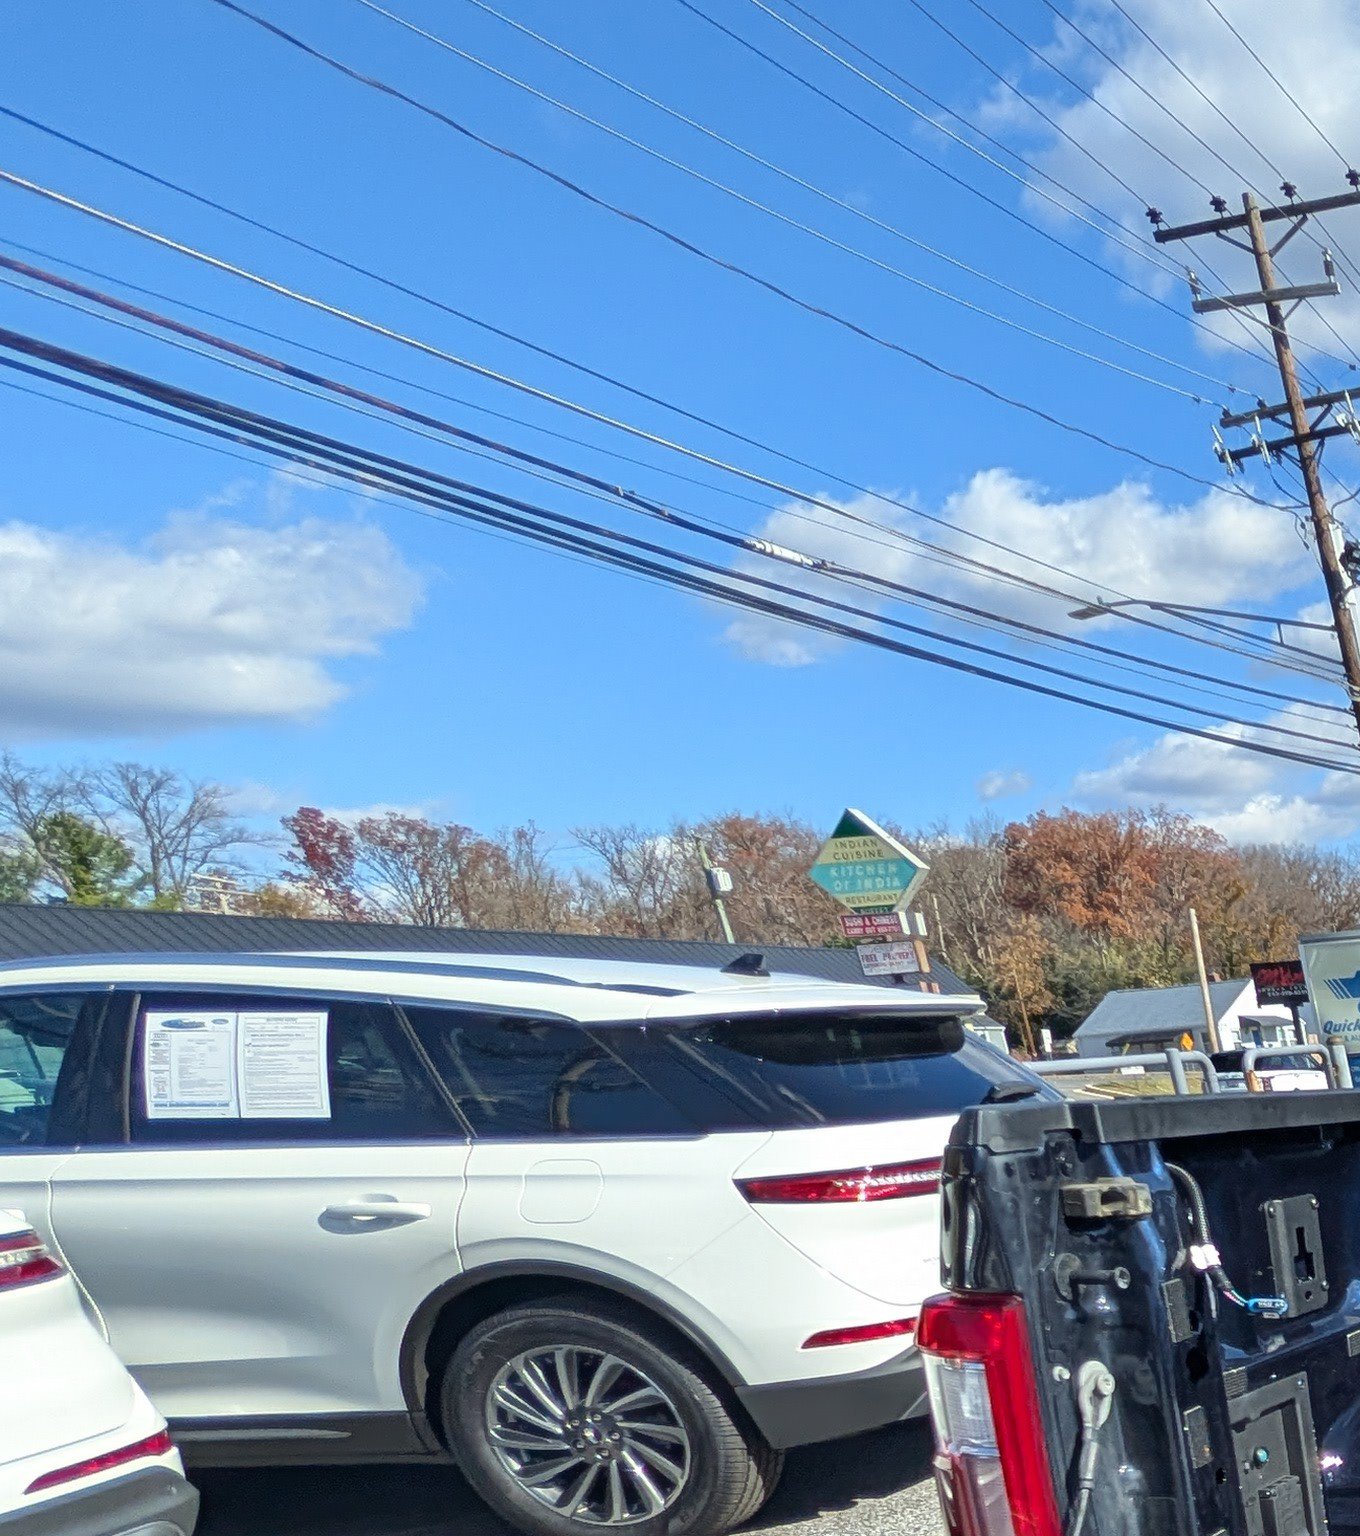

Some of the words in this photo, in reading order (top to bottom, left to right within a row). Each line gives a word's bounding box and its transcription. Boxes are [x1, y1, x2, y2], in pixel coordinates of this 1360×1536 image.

[834, 839, 878, 849] INDIAN
[833, 849, 884, 861] CUISINE
[830, 863, 898, 877] KITCHEN
[857, 877, 901, 889] INDIA
[845, 893, 898, 904] RESTAURANT
